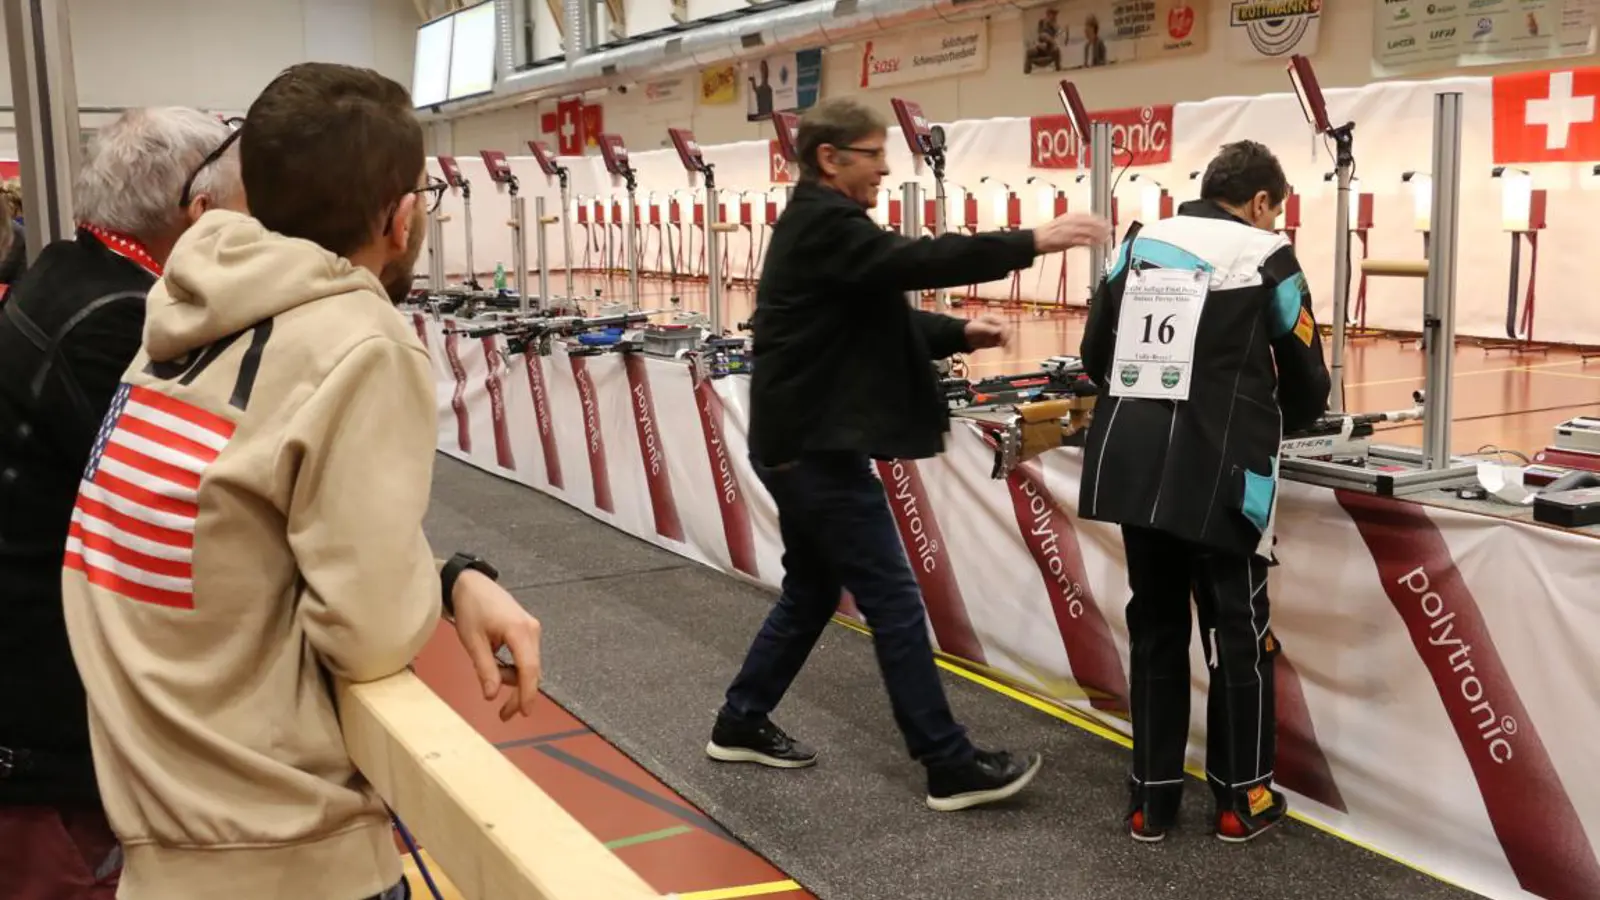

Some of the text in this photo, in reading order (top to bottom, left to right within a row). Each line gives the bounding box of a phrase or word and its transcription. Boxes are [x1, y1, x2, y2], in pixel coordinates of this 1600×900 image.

[1037, 106, 1168, 164] polonic
[1140, 313, 1177, 345] 16
[634, 383, 662, 476] polytronic
[1019, 478, 1085, 619] polytronic
[1397, 565, 1518, 765] polytronic
